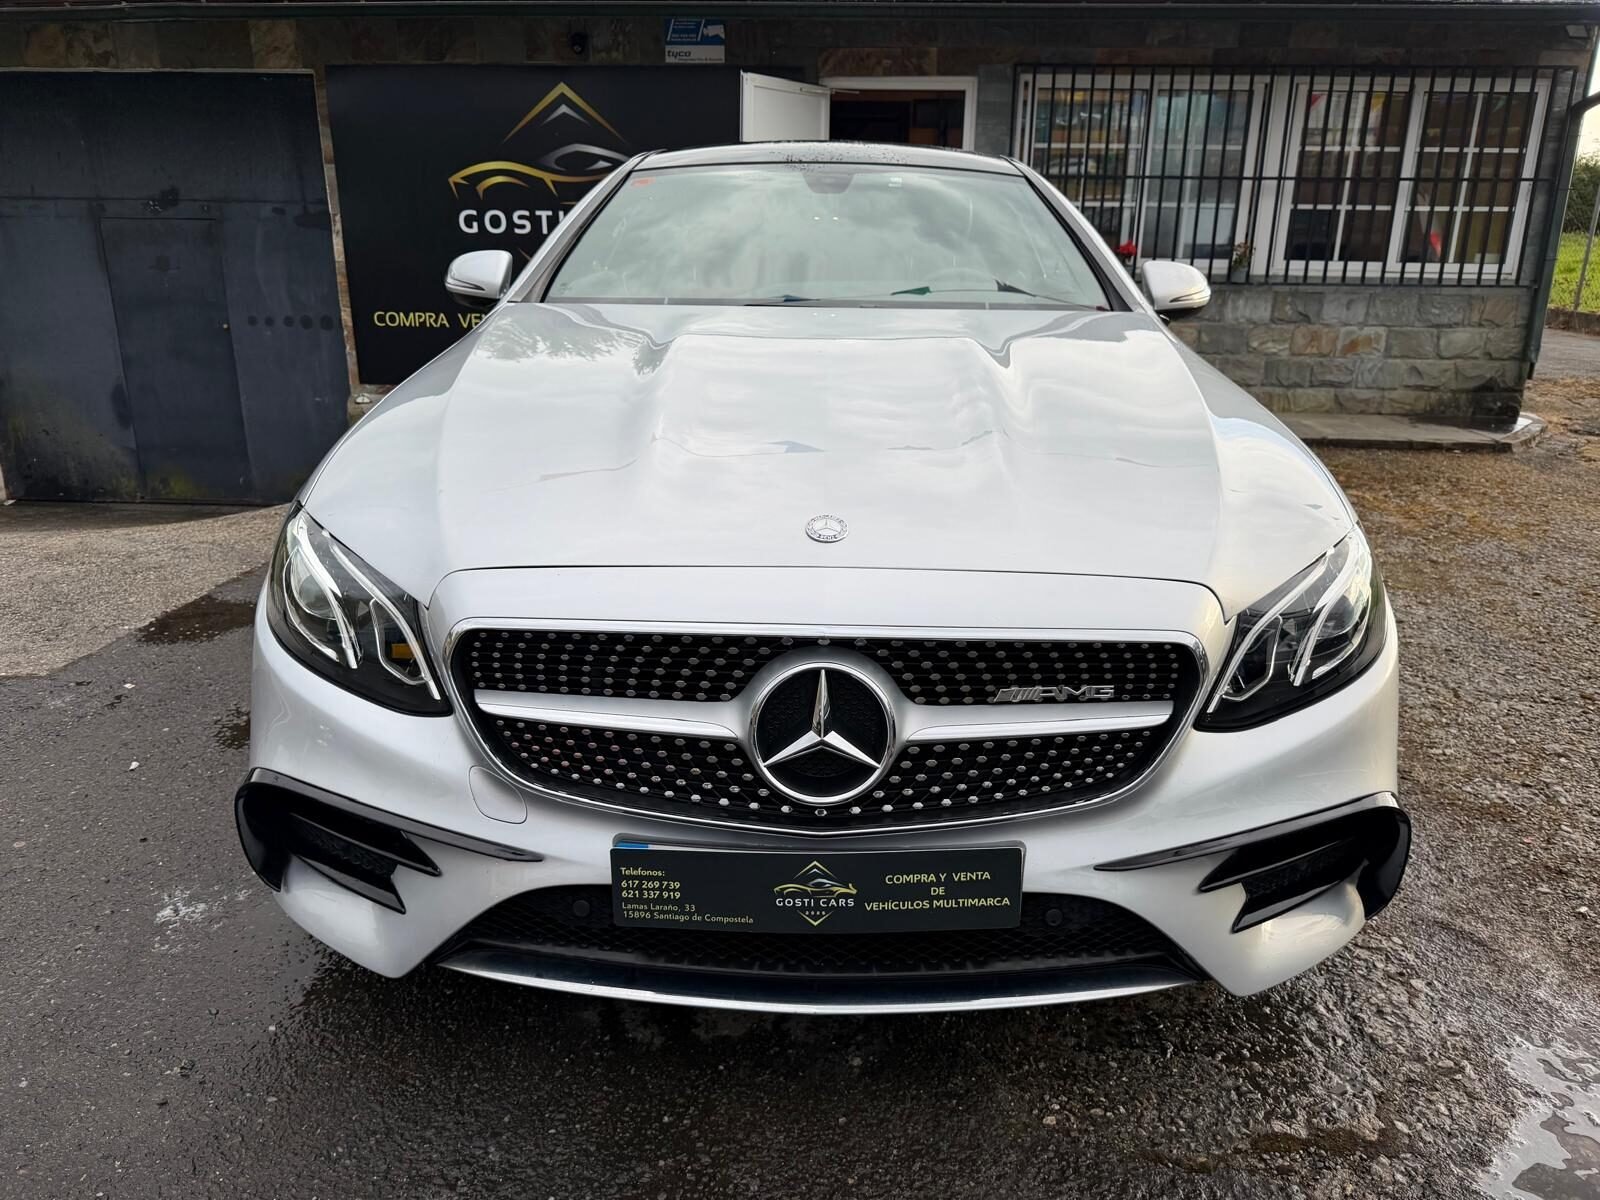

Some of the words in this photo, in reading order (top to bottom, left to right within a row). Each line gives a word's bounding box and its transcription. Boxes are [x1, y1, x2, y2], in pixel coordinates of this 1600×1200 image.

[667, 50, 692, 58] tyco
[374, 312, 450, 328] COMPRA
[458, 313, 486, 328] VE
[1036, 685, 1115, 700] AMG
[620, 867, 665, 876] Telefonos:
[886, 873, 936, 884] COMPRA
[939, 872, 947, 882] Y
[952, 871, 990, 882] VENTA
[621, 880, 640, 888] 617
[642, 880, 660, 889] 269
[662, 881, 680, 890] 739
[622, 890, 640, 898] 621
[642, 891, 660, 899] 337
[662, 891, 680, 900] 919
[930, 887, 946, 896] DE
[622, 902, 648, 910] Lamas
[776, 898, 814, 907] GOSTI
[820, 898, 854, 907] CARS
[864, 898, 930, 911] VEHÍCULOS
[933, 896, 1010, 908] MULTIMARCA
[624, 910, 651, 919] 15896
[654, 912, 690, 922] Santiago
[704, 914, 754, 924] Compostela
